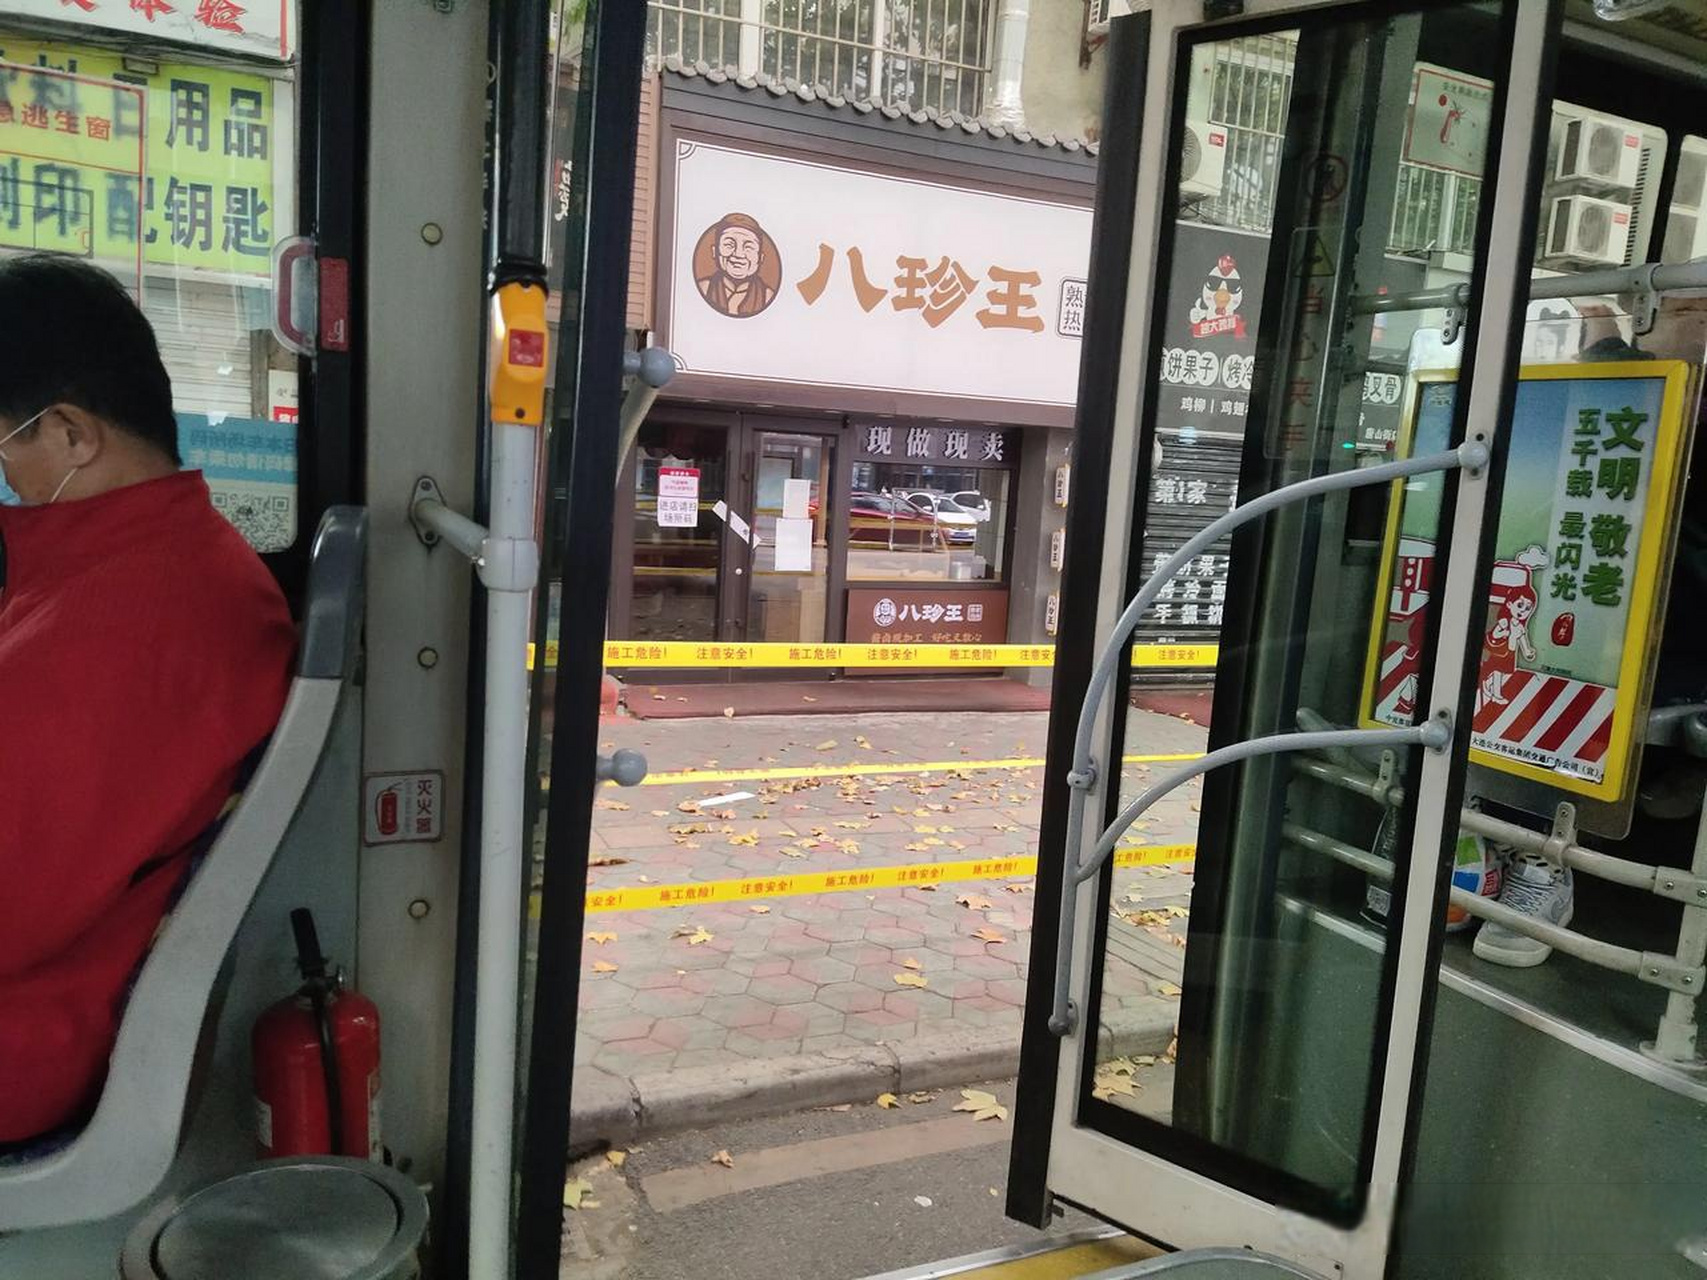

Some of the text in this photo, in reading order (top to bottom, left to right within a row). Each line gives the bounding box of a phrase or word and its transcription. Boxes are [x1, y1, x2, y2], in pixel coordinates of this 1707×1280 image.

[796, 242, 1045, 334] 八珍王
[1161, 350, 1215, 384] 饼果子
[1363, 373, 1397, 402] 叉骨
[1220, 400, 1249, 417] 鸡翅
[866, 425, 1004, 462] 现做现卖
[1566, 407, 1601, 498] 五千载
[1581, 405, 1648, 607] 文明 敬老
[1550, 512, 1587, 600] 最闪光
[899, 604, 964, 623] 八珍王
[1020, 649, 1054, 661] 注意安
[416, 780, 432, 833] 灭火器
[585, 895, 622, 907] 安全!
[1165, 848, 1195, 860] 注意安
